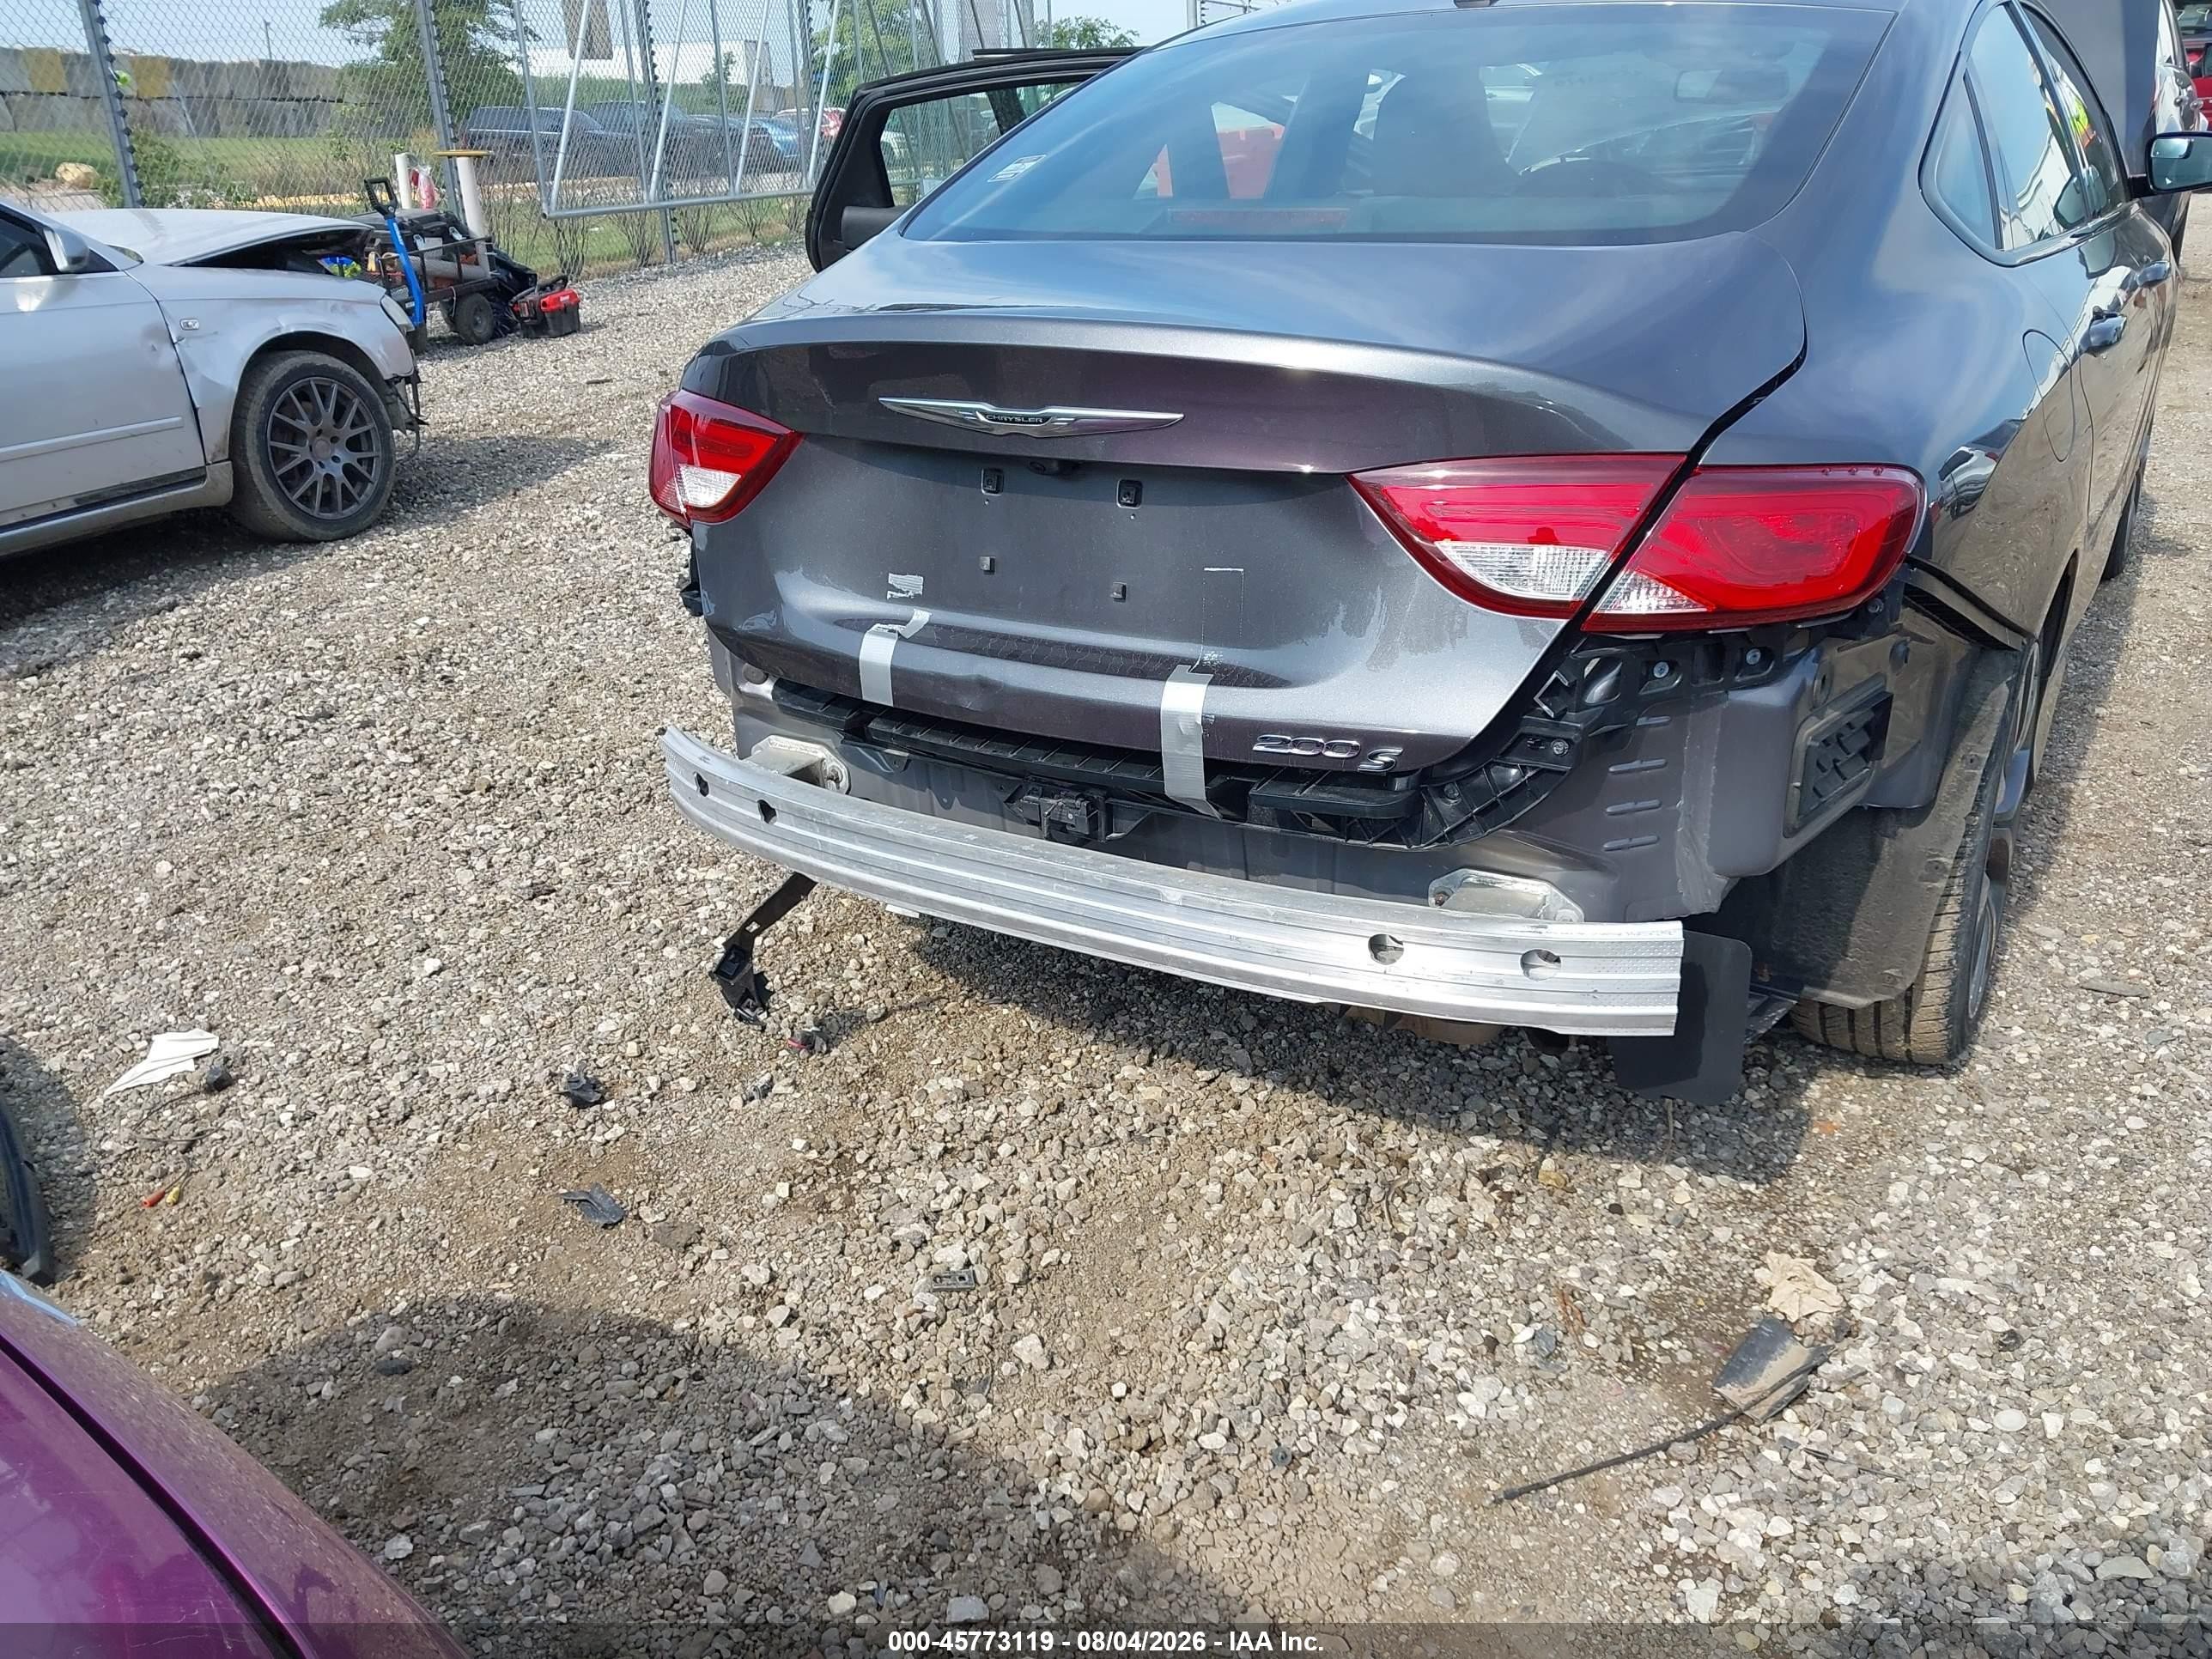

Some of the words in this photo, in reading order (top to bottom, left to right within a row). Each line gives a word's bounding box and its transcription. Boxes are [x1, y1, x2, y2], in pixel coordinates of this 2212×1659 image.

[986, 414, 1043, 423] CHRYSLER
[1252, 734, 1361, 759] 200
[1357, 747, 1404, 773] S
